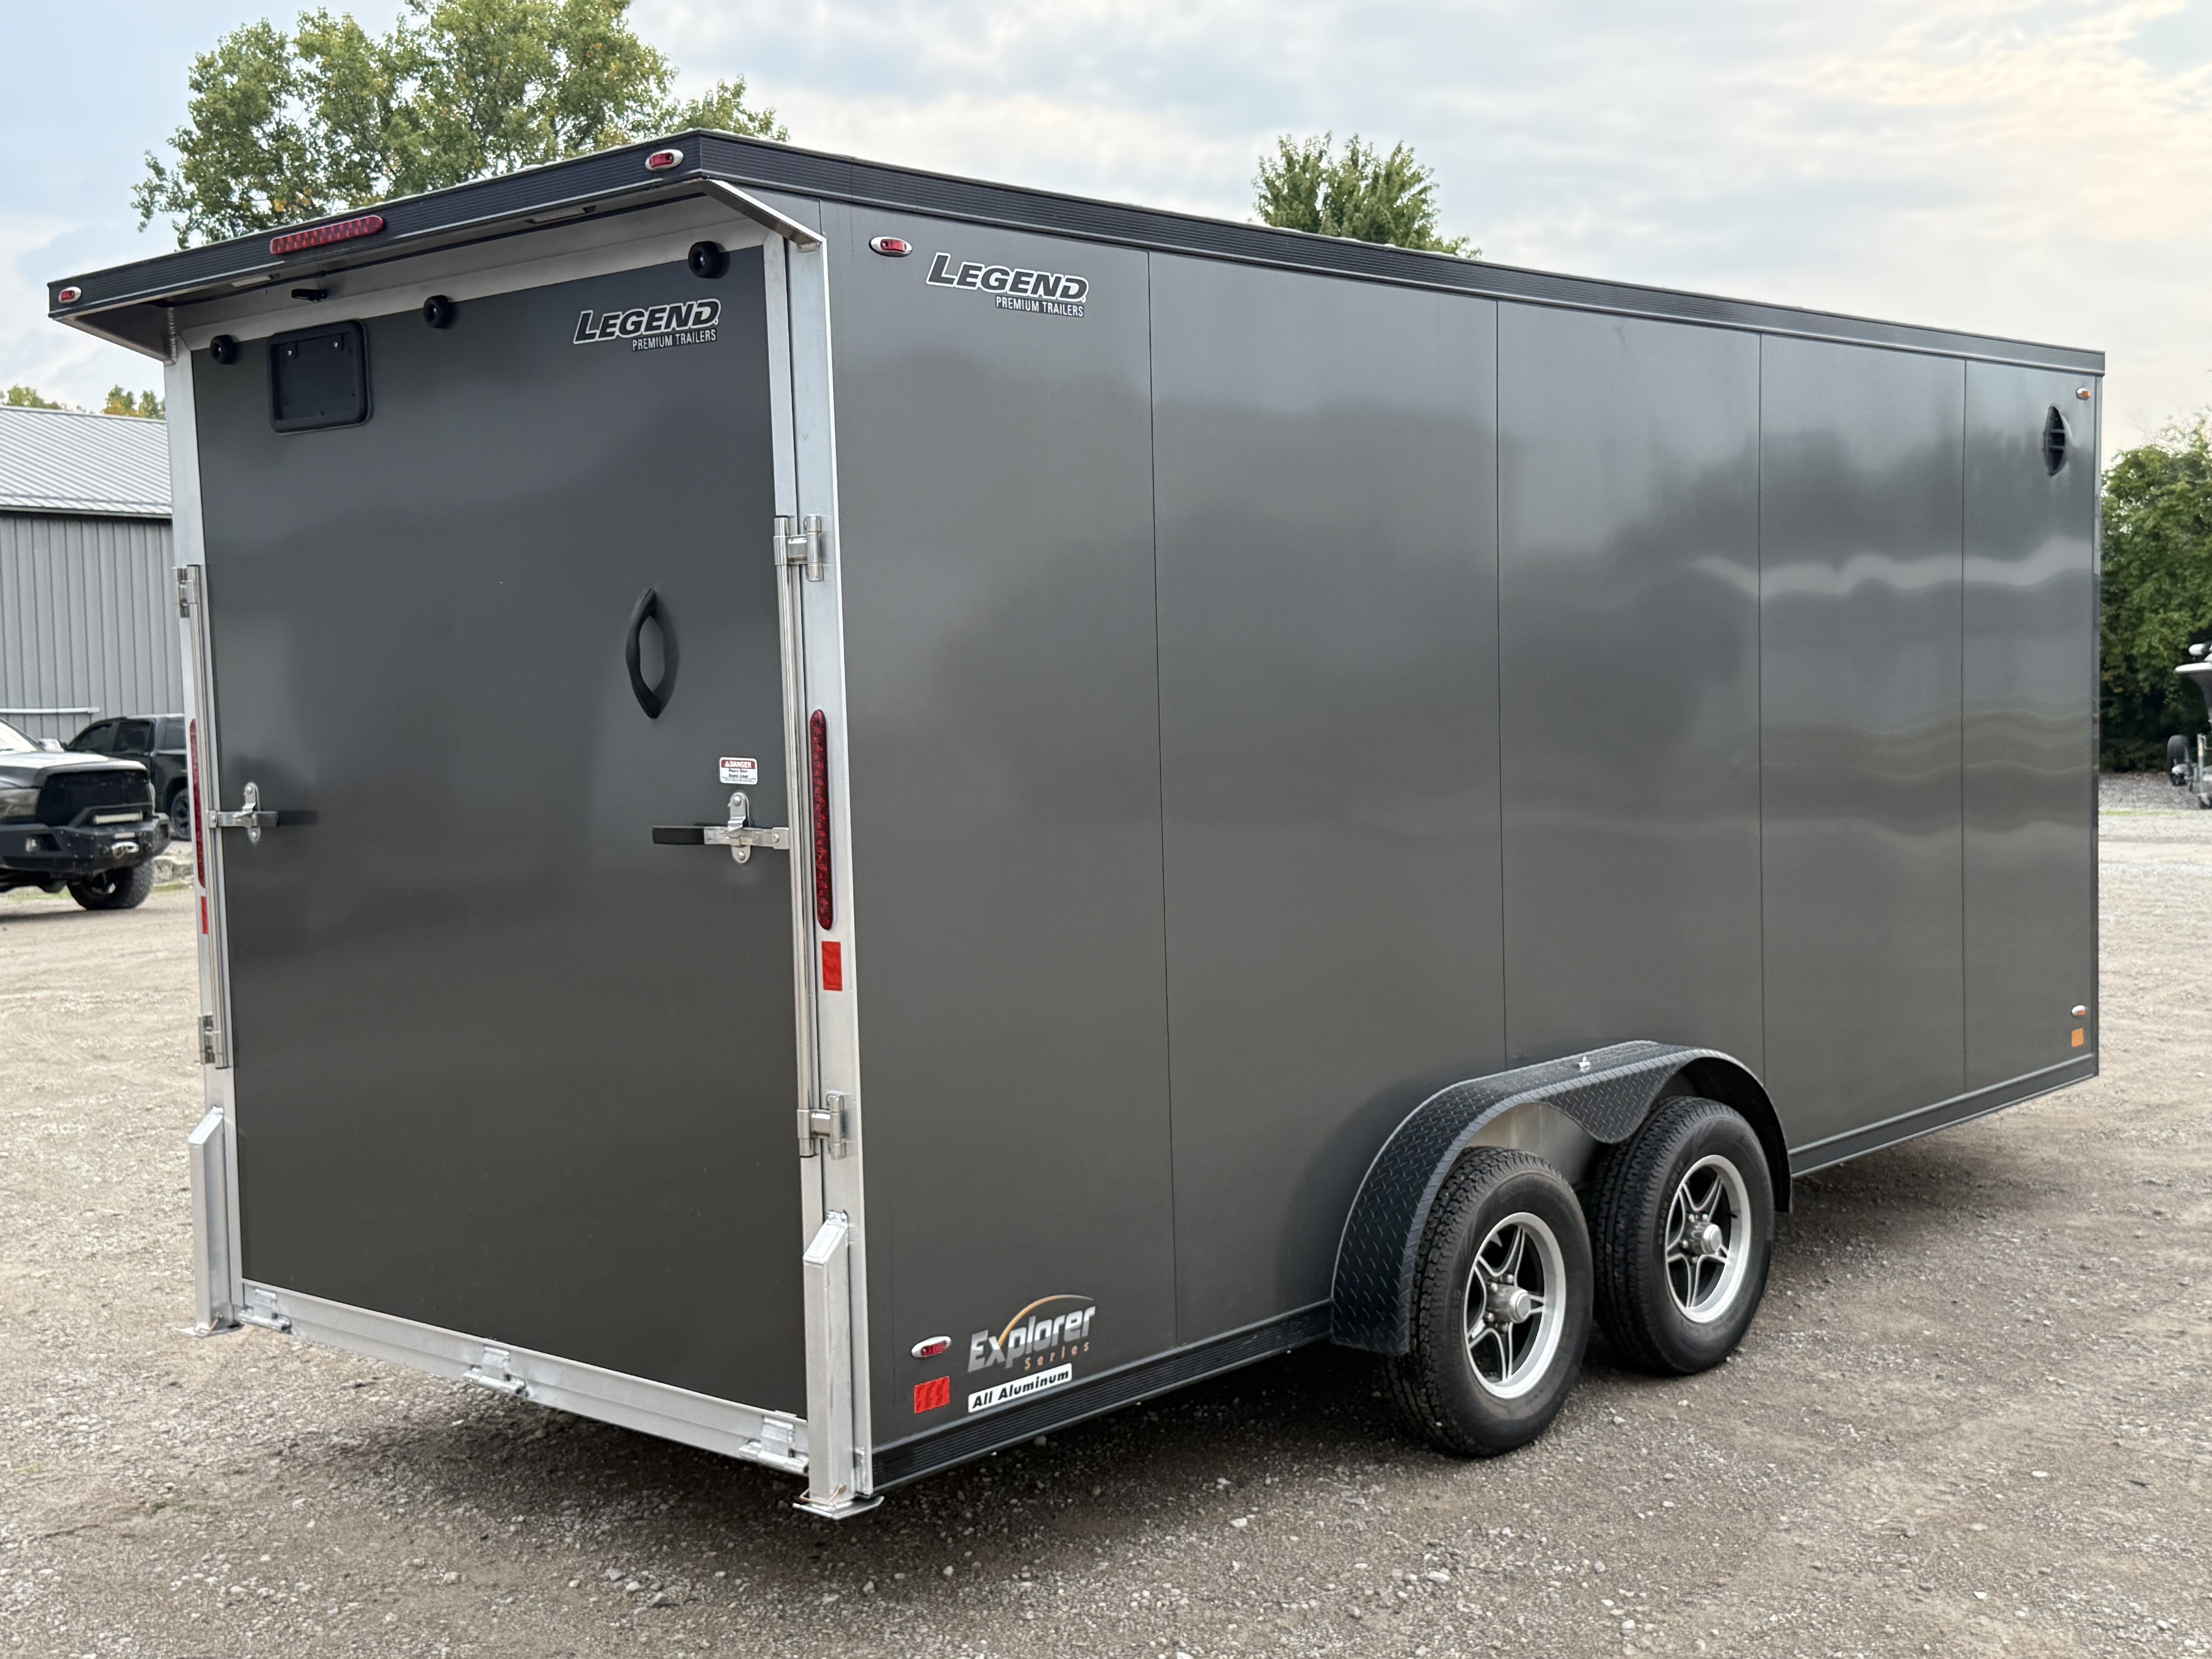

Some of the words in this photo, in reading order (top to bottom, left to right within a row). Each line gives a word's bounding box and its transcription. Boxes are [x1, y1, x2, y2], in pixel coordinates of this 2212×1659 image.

[926, 252, 1089, 302] LEGEND
[573, 299, 721, 344] LEGEND
[996, 296, 1039, 312] PREMIUM
[1043, 302, 1084, 317] TRAILERS
[632, 336, 673, 351] PREMIUM
[676, 329, 716, 345] TRAILERS
[968, 1306, 1096, 1372] Explorer
[972, 1391, 993, 1409] All
[998, 1370, 1069, 1400] Aluminum
